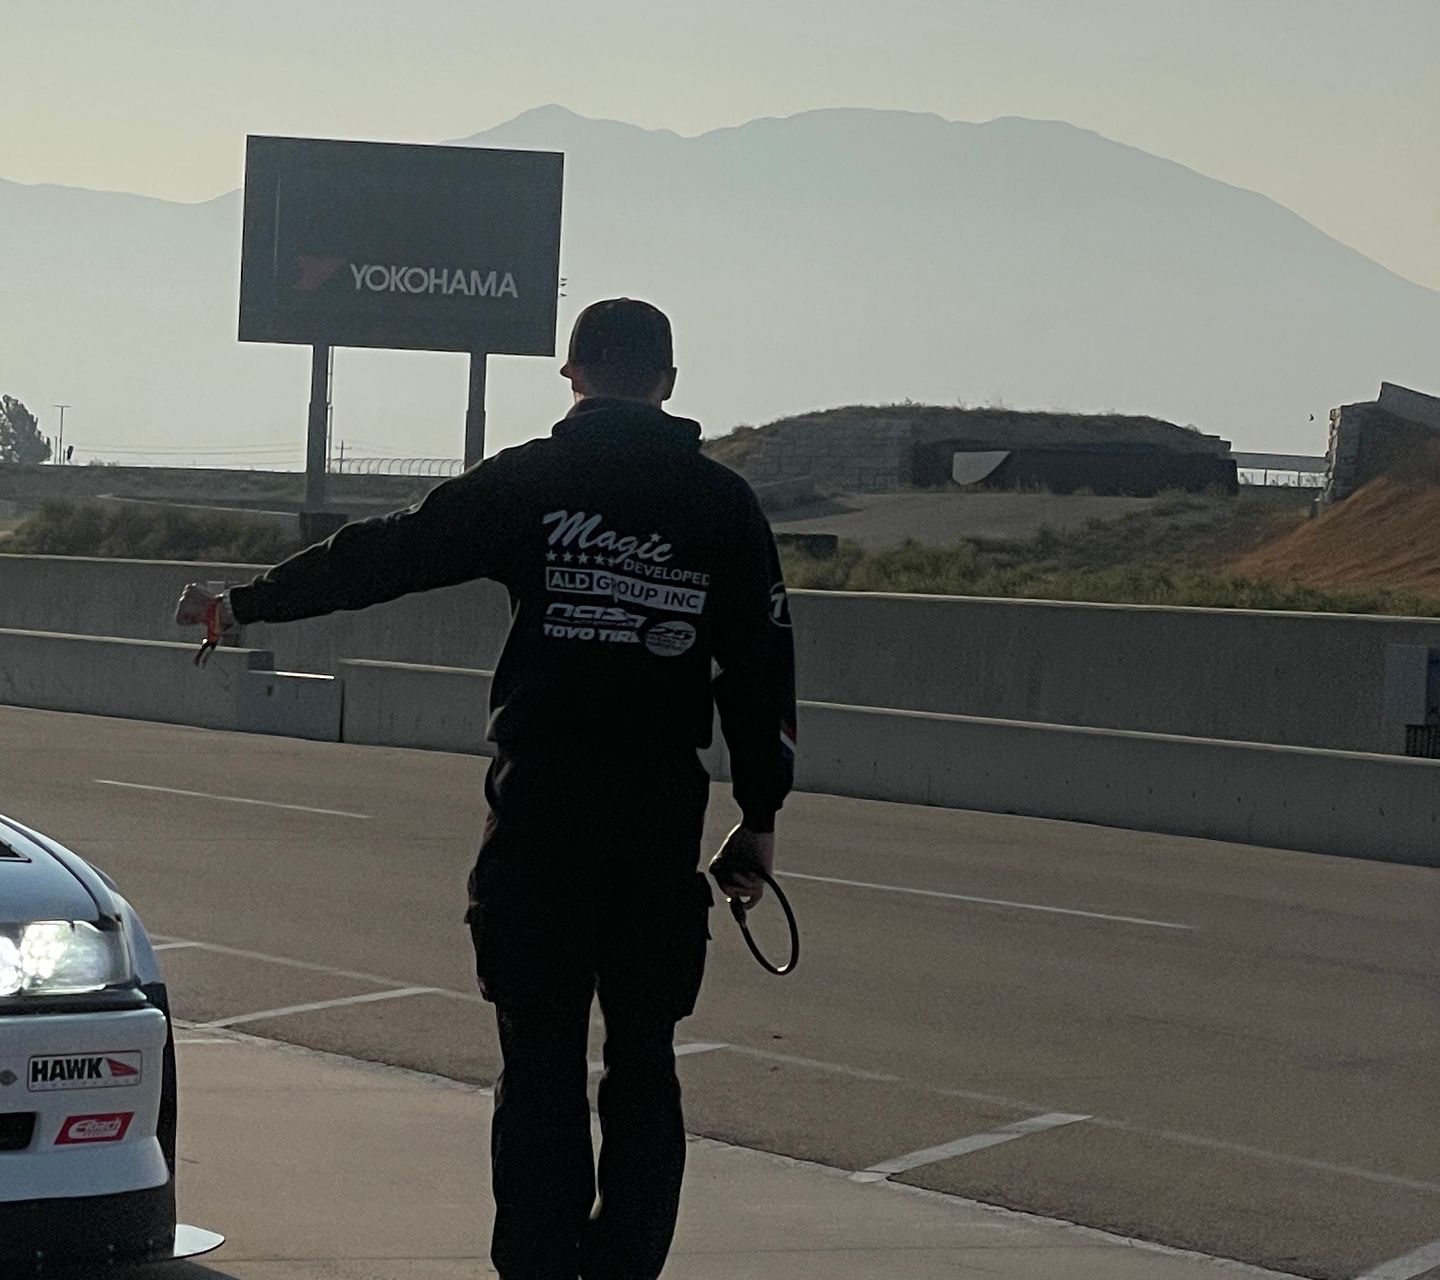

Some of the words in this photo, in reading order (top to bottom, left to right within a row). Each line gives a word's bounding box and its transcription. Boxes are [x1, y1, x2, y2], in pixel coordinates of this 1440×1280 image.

[350, 263, 519, 299] YOKOHAMA
[542, 510, 673, 565] Magic
[550, 571, 590, 589] ALD
[664, 591, 700, 609] INC
[32, 1057, 105, 1082] HAWK
